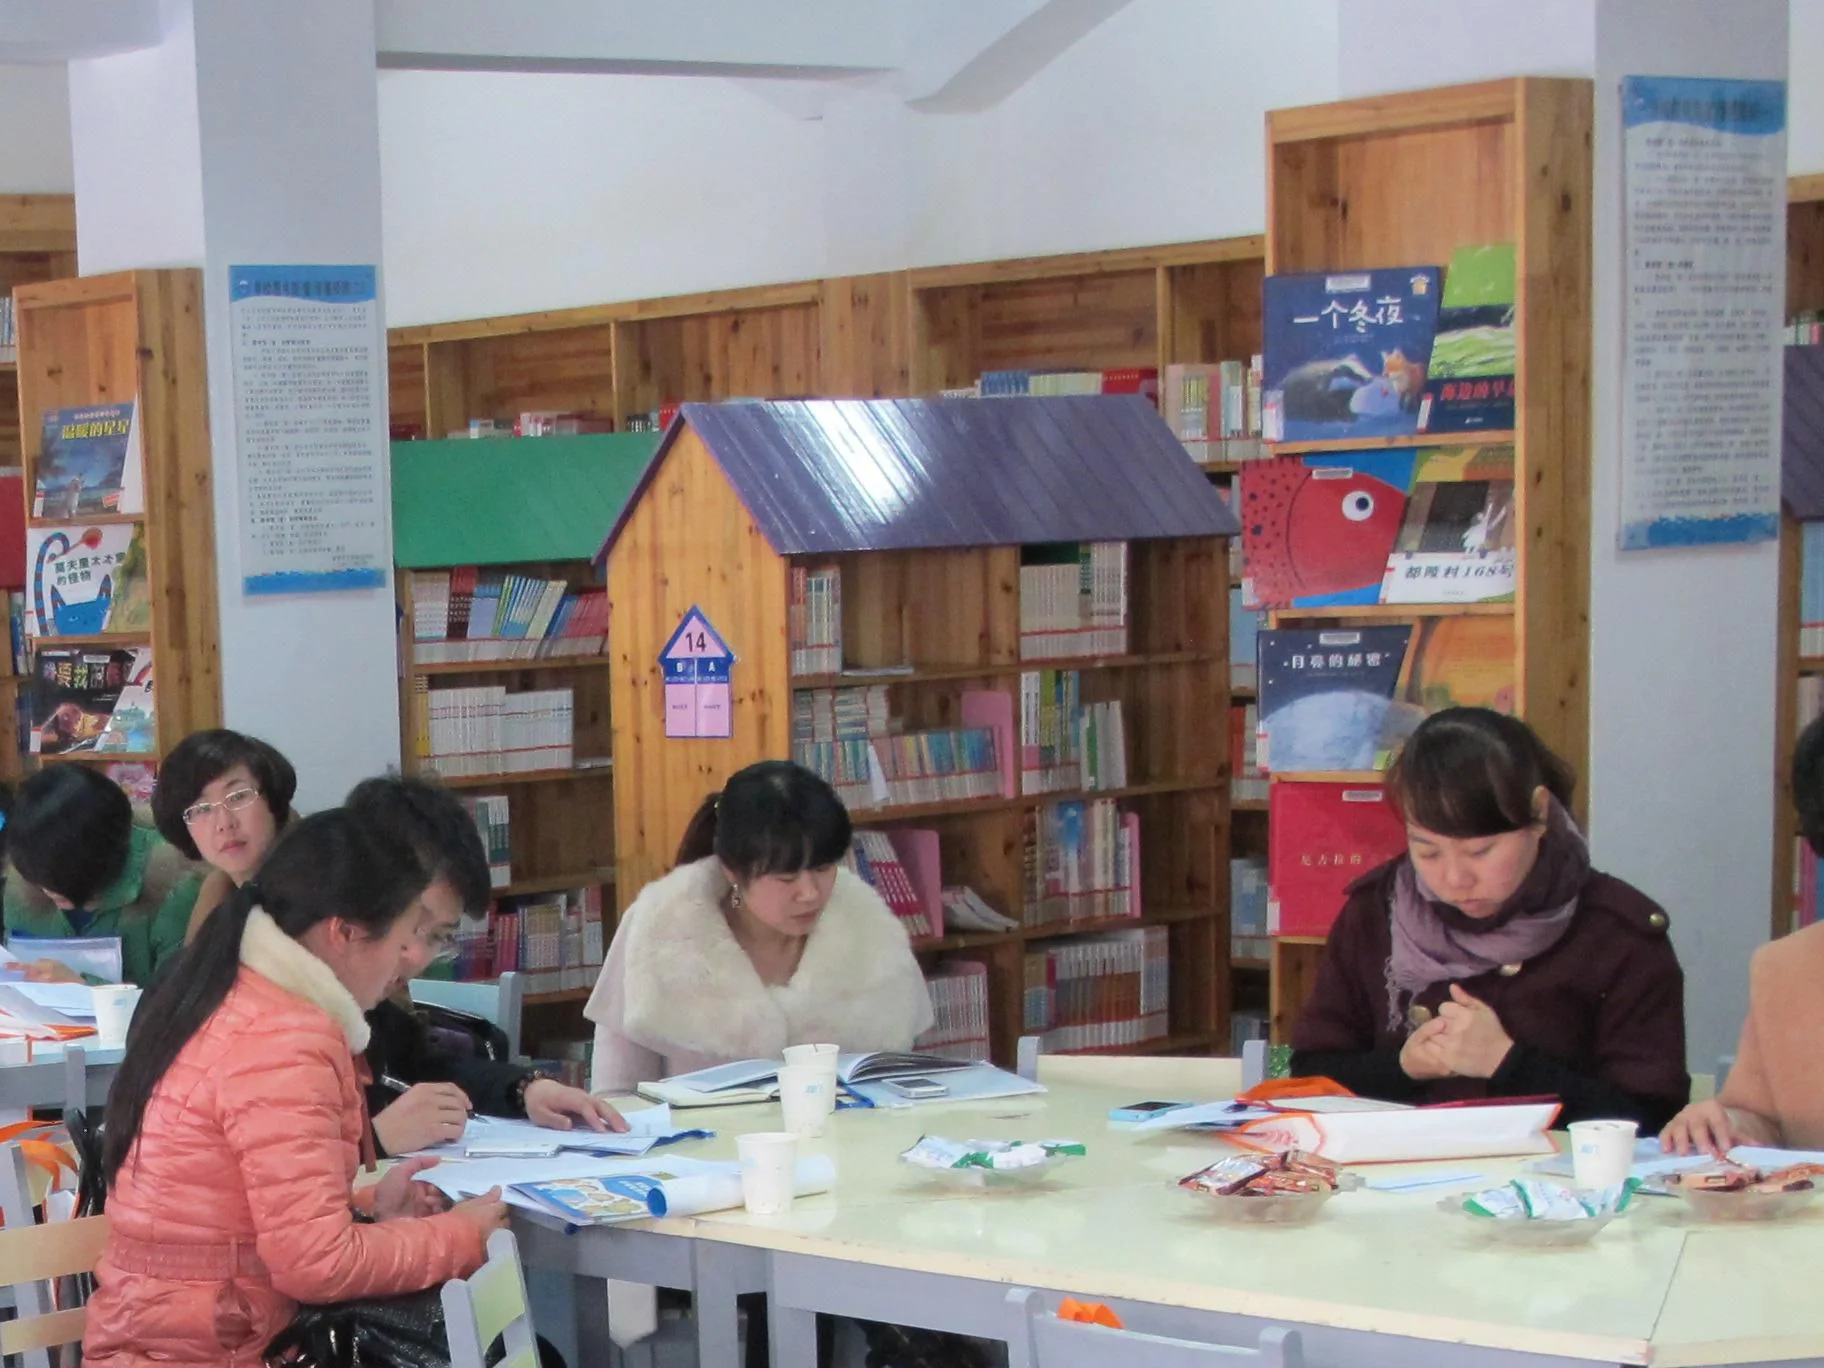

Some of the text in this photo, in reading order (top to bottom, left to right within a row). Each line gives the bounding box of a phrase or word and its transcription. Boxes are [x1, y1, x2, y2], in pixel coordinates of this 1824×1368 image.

[1293, 295, 1404, 334] 一个冬夜
[685, 632, 706, 653] 14
[708, 661, 716, 673] A
